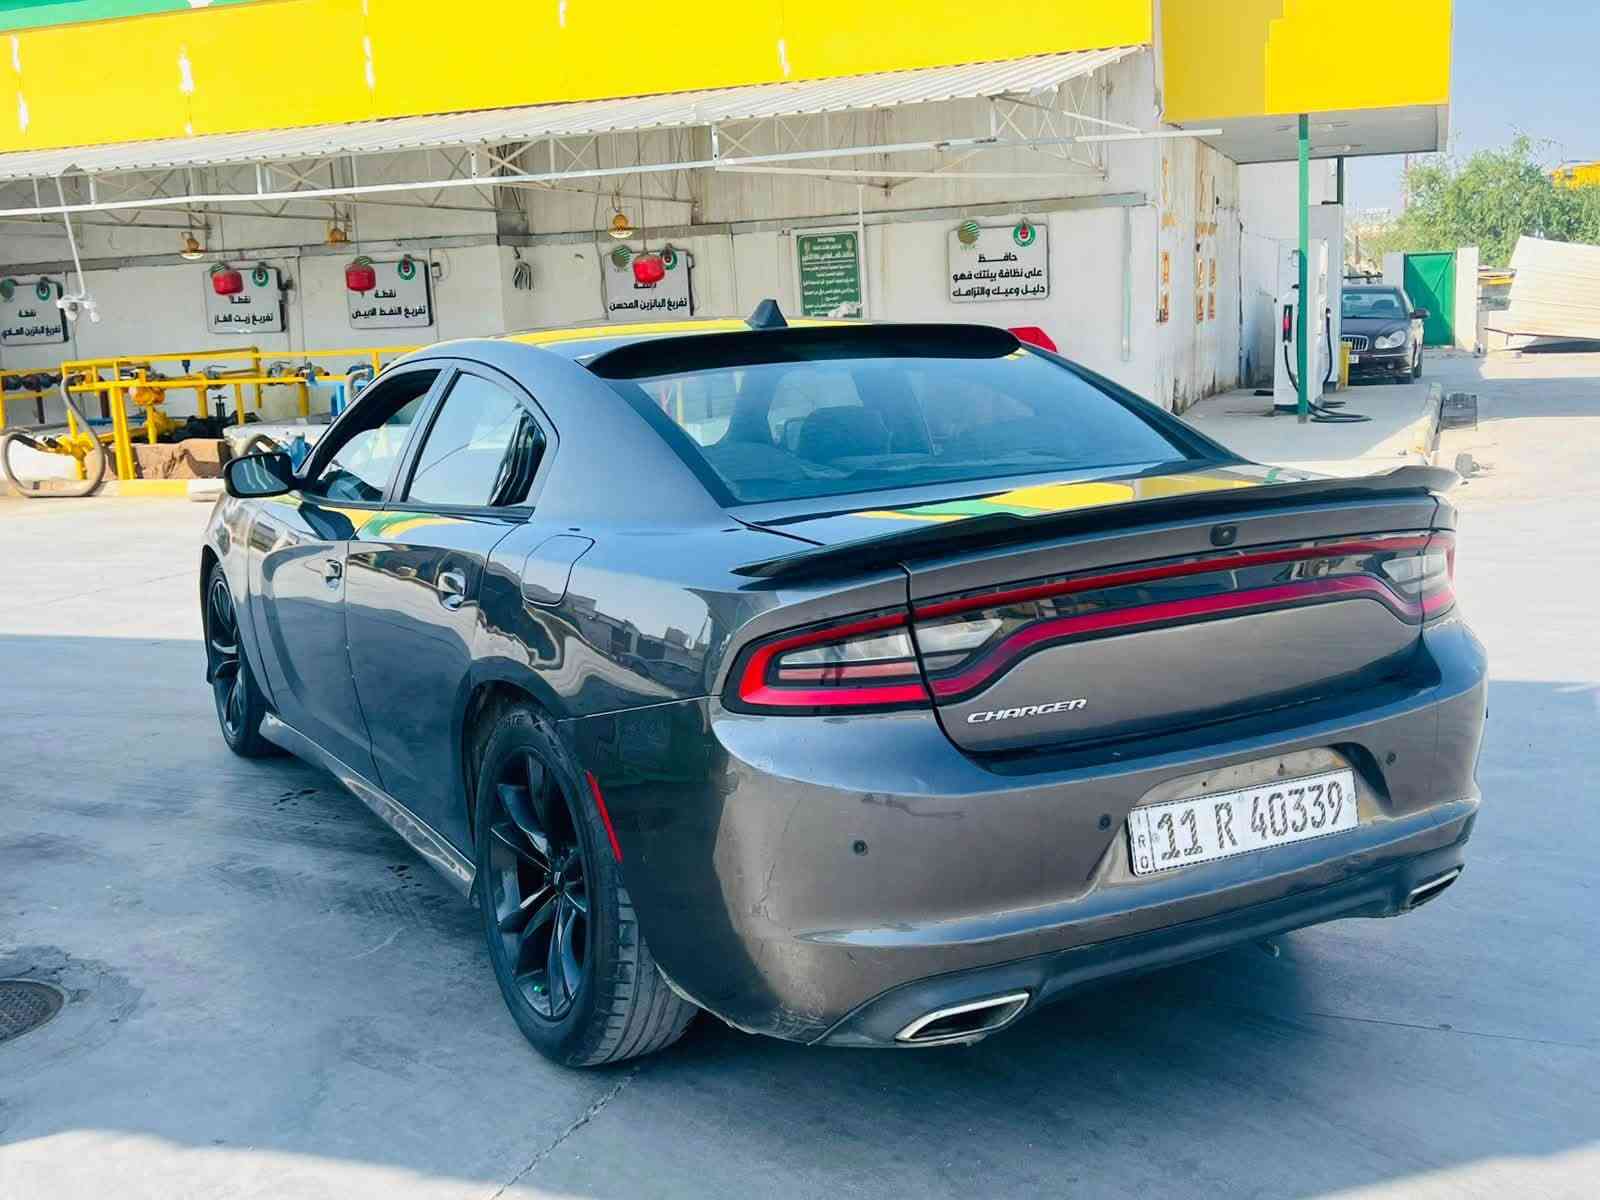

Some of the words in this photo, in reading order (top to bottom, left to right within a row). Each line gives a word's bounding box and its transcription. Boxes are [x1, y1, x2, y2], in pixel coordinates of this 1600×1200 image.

[978, 252, 1018, 262] حافظ
[952, 271, 972, 282] فهو
[974, 268, 997, 281] بيئتك
[998, 268, 1023, 278] نظافة
[1024, 267, 1042, 278] على
[952, 286, 990, 298] والتزامك
[992, 285, 1019, 296] وعيك
[1021, 284, 1045, 295] دليل
[609, 299, 638, 311] المحسن
[667, 297, 687, 311] تفريغ
[404, 304, 426, 318] تفريغ
[967, 699, 1087, 723] CHARGER
[1157, 808, 1203, 861] 11
[1214, 801, 1238, 849] R
[1250, 780, 1343, 840] 40339
